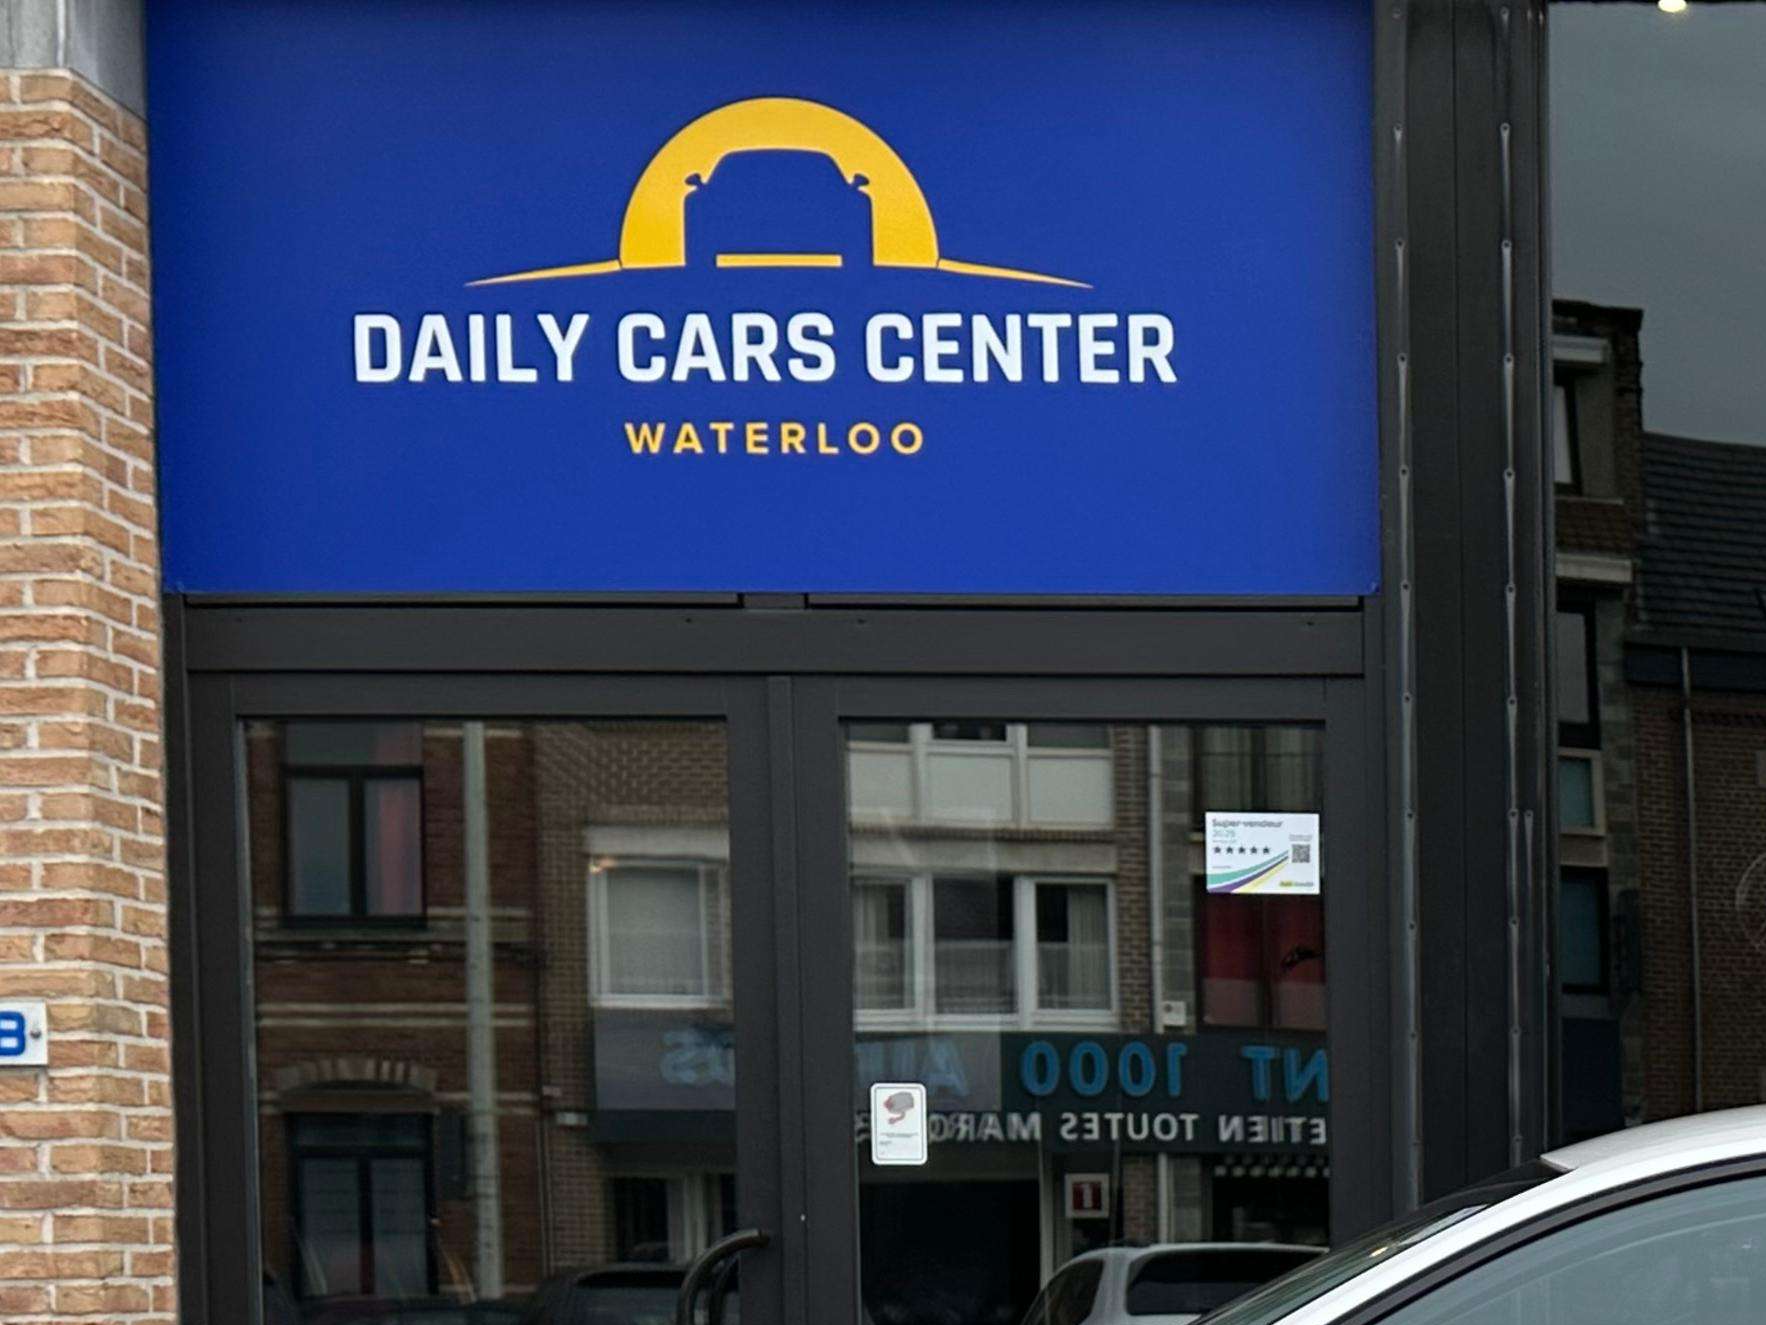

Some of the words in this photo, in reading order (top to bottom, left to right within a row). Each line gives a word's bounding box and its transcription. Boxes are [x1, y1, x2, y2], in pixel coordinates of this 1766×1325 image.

[353, 312, 590, 384] DAILY
[618, 312, 836, 384] CARS
[866, 312, 1178, 384] CENTER
[624, 422, 924, 455] WATERLOO
